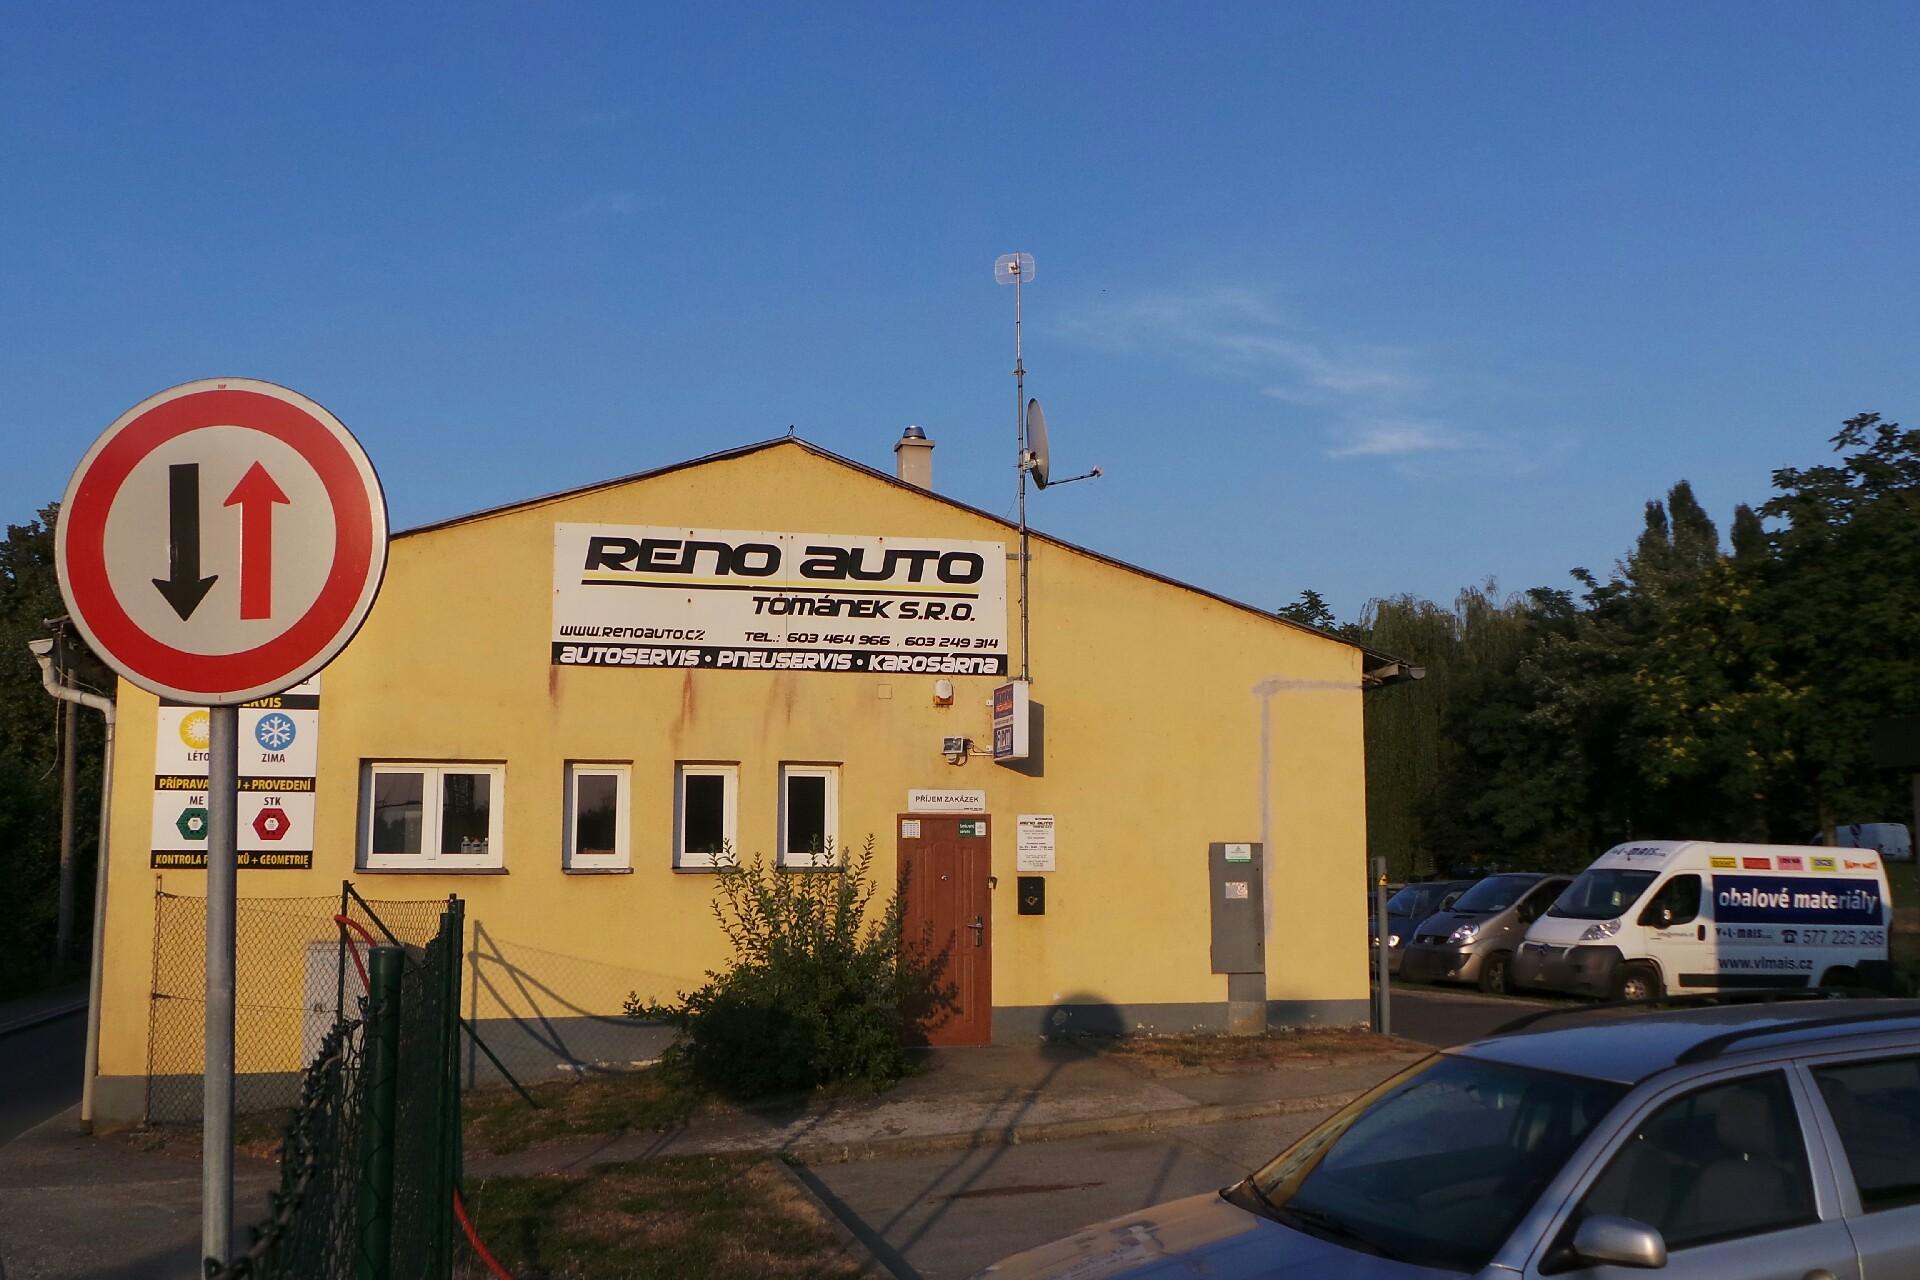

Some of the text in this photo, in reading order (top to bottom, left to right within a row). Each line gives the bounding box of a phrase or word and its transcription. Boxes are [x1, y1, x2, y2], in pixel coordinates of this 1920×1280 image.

[898, 601, 976, 622] S.R.O.
[787, 632, 819, 644] 603
[822, 633, 855, 645] 464
[858, 634, 891, 646] 966
[904, 636, 936, 647] 603
[938, 637, 971, 648] 249
[974, 638, 999, 649] 314
[261, 753, 286, 763] ZIMA
[251, 778, 311, 791] PROVEDENÍ
[189, 796, 204, 806] ME
[264, 796, 281, 806] STK
[915, 794, 979, 803] PŘÍJEM ZAKÁZEK
[156, 854, 201, 865] KONTROLA
[260, 854, 309, 865] GEOMETRIE
[1718, 886, 1878, 915] obalové materiály
[1803, 929, 1828, 945] 577
[1860, 930, 1884, 946] 295
[1718, 956, 1814, 970] www.vlmais.cz
